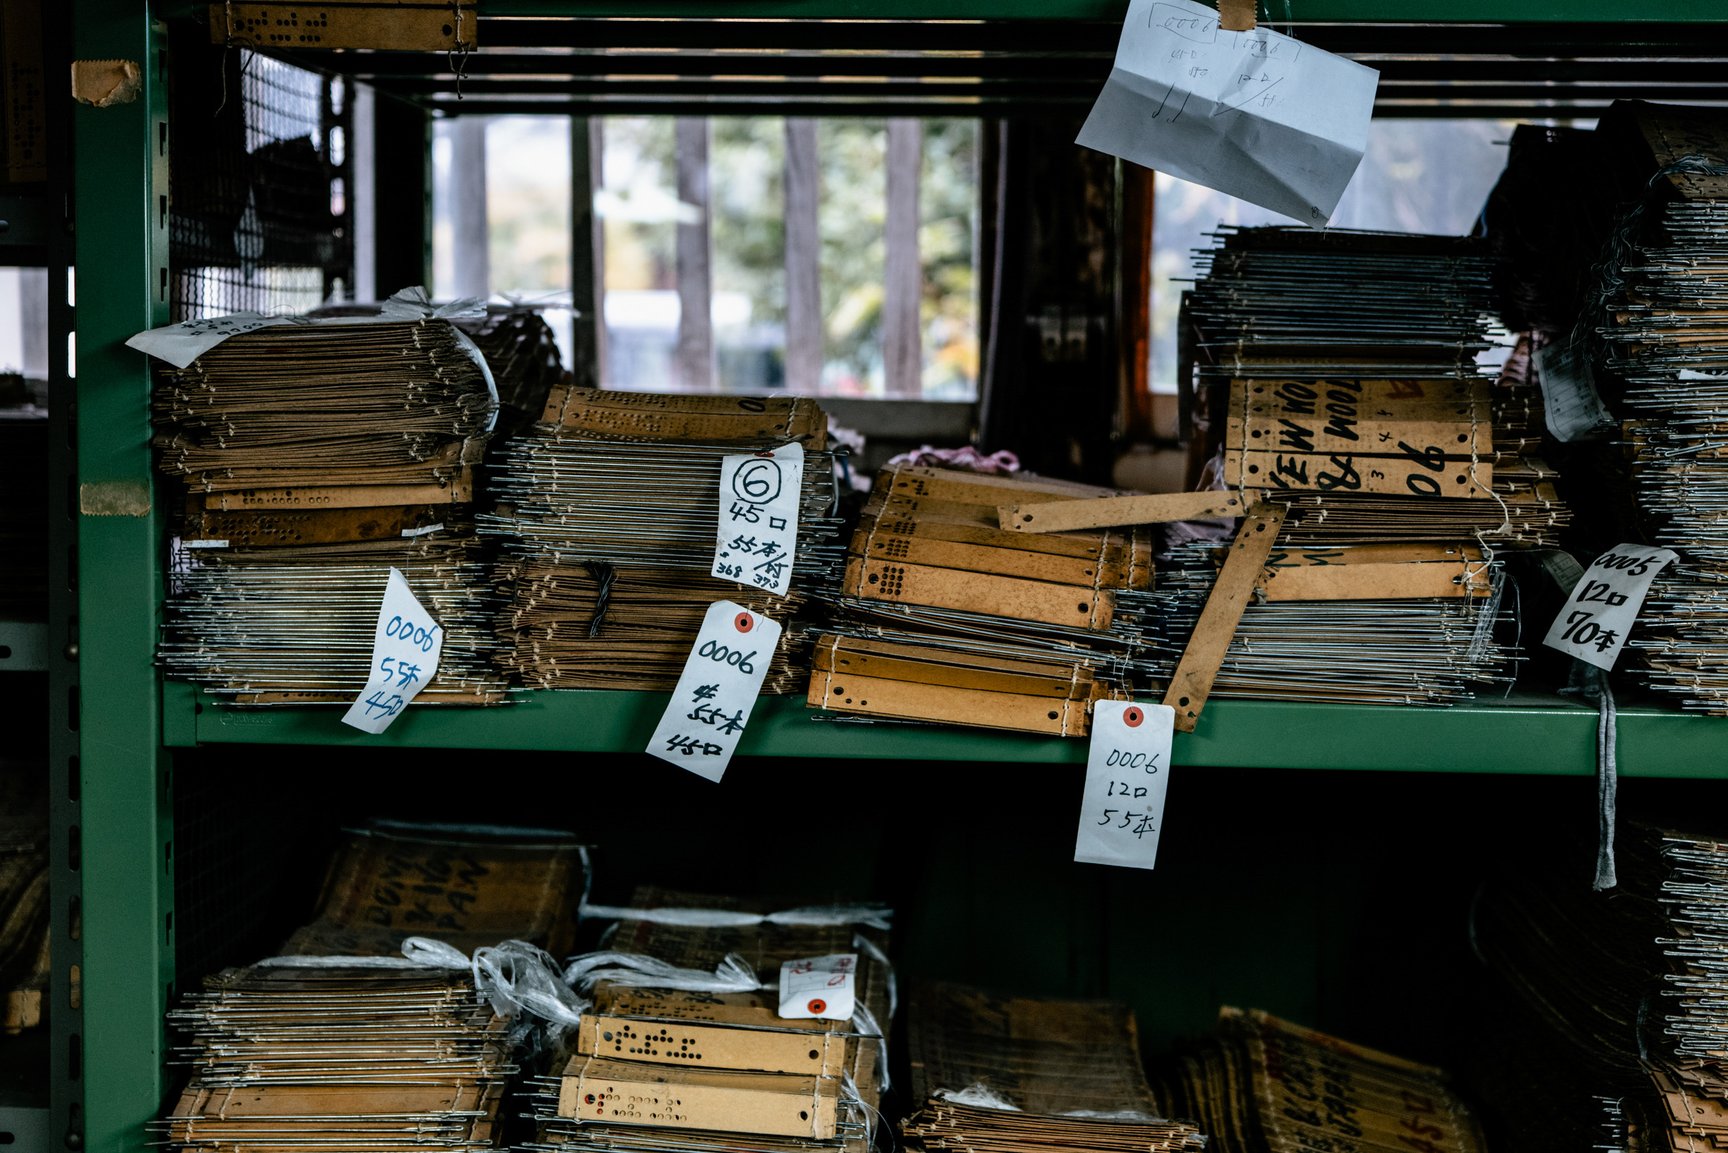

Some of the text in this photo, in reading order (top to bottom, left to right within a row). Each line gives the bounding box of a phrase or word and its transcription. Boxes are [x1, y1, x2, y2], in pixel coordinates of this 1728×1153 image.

[753, 573, 779, 589] 373
[386, 615, 439, 653] 0006
[698, 640, 758, 675] 0006
[1106, 748, 1160, 775] 0006
